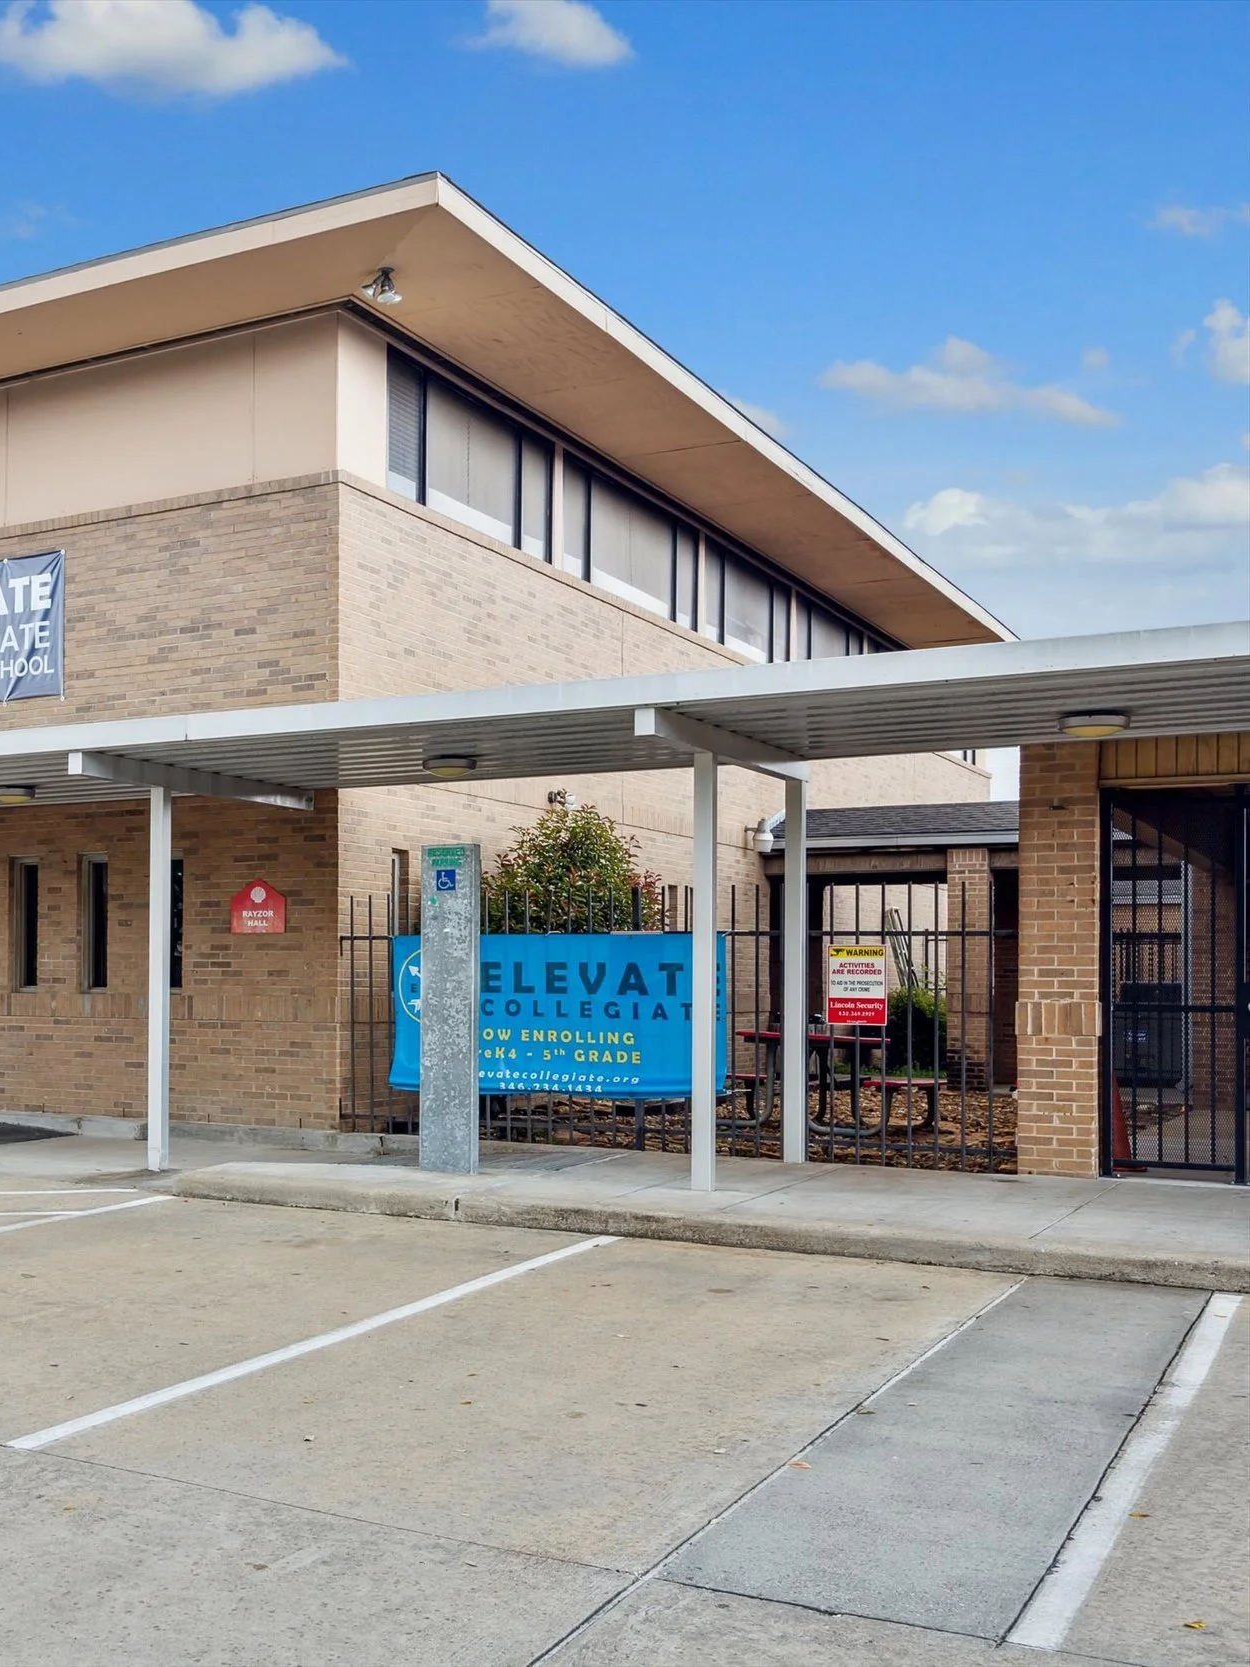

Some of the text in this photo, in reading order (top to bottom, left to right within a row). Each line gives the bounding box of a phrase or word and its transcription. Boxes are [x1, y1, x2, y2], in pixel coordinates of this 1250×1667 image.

[846, 949, 884, 957] WARNING
[480, 961, 720, 997] ELEVAT
[856, 1001, 883, 1010] Security
[482, 1028, 635, 1045] OW ENROLLING
[543, 1048, 565, 1061] 5th
[574, 1049, 641, 1064] GRADE
